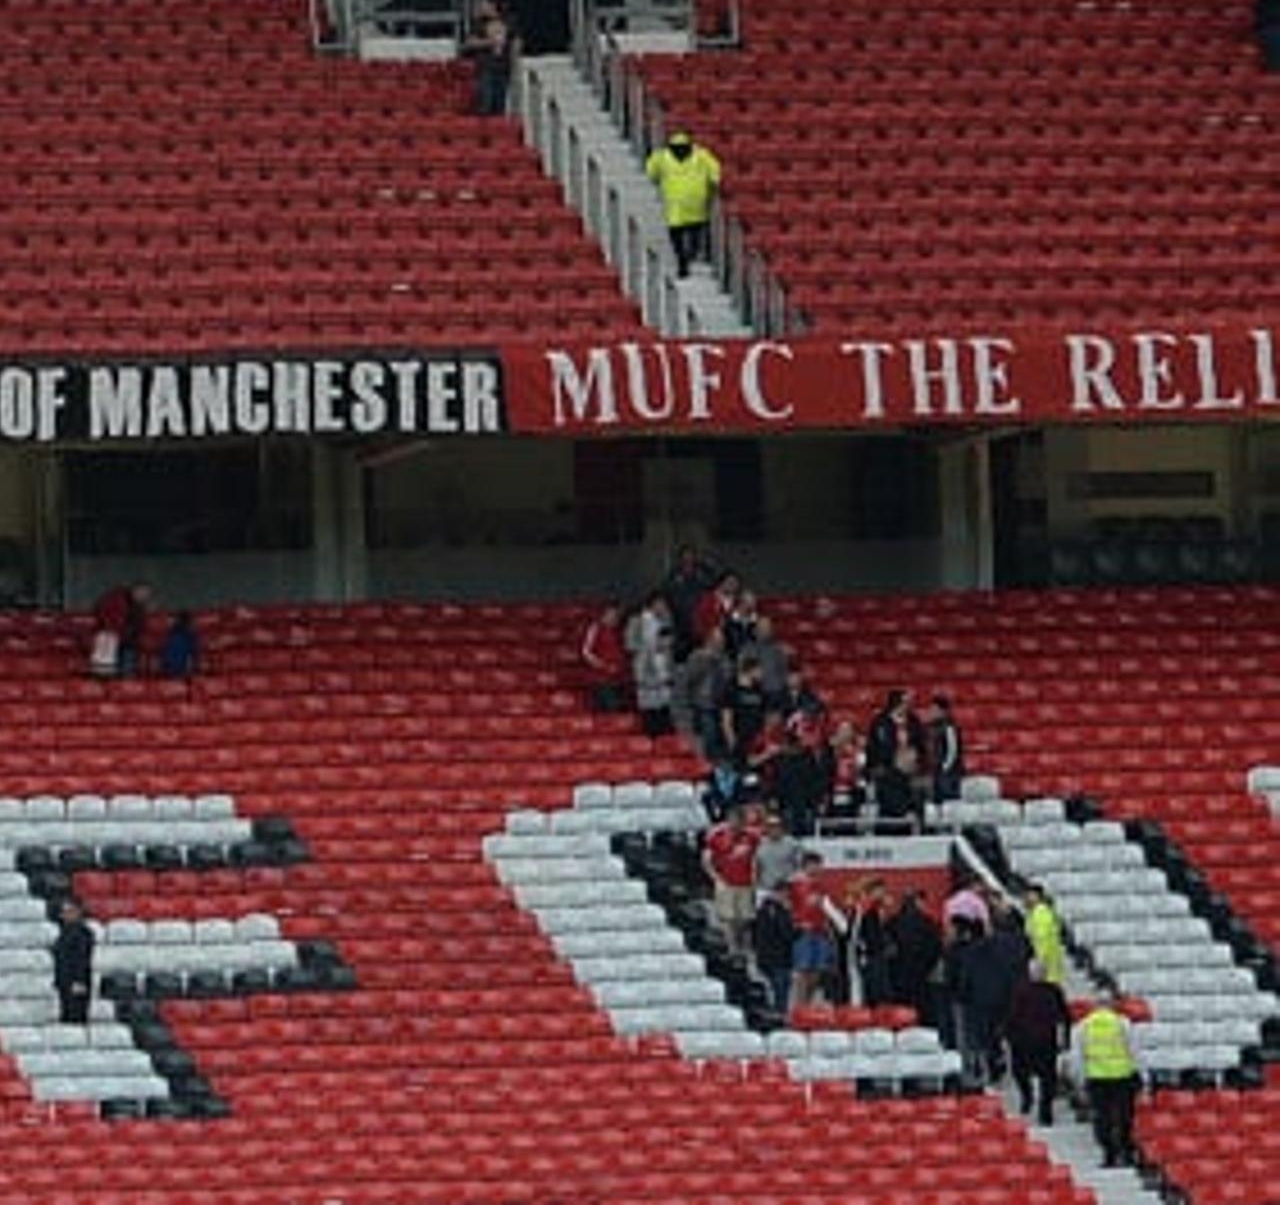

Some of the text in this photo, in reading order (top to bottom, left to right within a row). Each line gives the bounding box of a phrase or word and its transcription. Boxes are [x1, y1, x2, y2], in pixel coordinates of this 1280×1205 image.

[88, 361, 500, 439] MANCHESTER
[545, 341, 795, 426] MUFC
[842, 335, 1022, 419] THE
